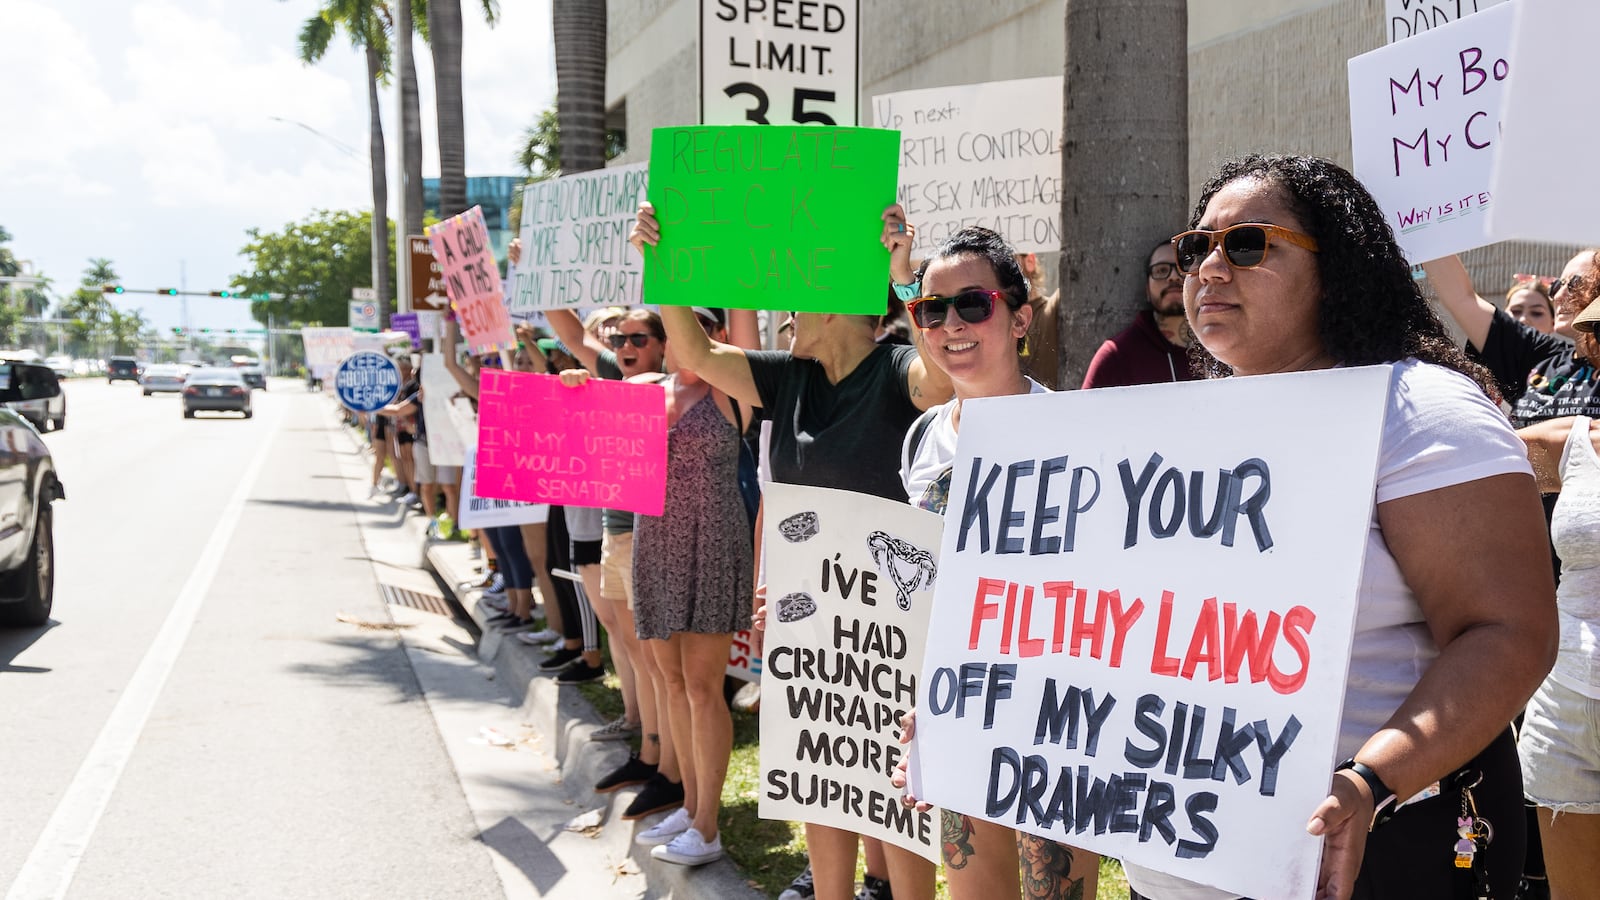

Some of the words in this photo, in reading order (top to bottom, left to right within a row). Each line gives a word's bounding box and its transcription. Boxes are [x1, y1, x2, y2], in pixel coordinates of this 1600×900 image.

[716, 0, 845, 33] SPEED
[730, 36, 832, 75] LIMIT
[1459, 47, 1510, 95] BO
[723, 82, 837, 126] 35
[878, 98, 903, 129] Up
[914, 102, 960, 124] next:
[672, 130, 857, 174] REGULATE
[898, 135, 946, 168] RTH
[957, 127, 1062, 163] CONTROL
[663, 184, 820, 232] DICK
[923, 180, 963, 214] SEX
[972, 174, 1064, 209] MARRIAGE
[441, 235, 456, 265] A
[527, 226, 561, 267] MORE
[570, 218, 636, 266] SUPREME
[448, 270, 467, 300] IN
[512, 270, 544, 307] THAN
[550, 268, 583, 307] THIS
[590, 268, 639, 304] COURT
[652, 246, 716, 285] NOT
[737, 248, 836, 291] JANE
[338, 369, 398, 387] ABORTION
[348, 353, 388, 370] KEEP
[481, 370, 526, 396] IF
[343, 386, 394, 404] LEGAL
[481, 425, 521, 448] IN
[534, 431, 566, 451] MY
[584, 435, 645, 456] UTERUS
[482, 447, 505, 469] I
[513, 452, 587, 475] WOULD
[502, 473, 517, 494] A
[536, 478, 623, 502] SENATOR
[956, 454, 1101, 555] KEEP
[1117, 452, 1274, 553] YOUR
[821, 552, 878, 607] I'VE
[833, 615, 908, 660] HAD
[968, 577, 1145, 668] FILTHY
[1150, 590, 1316, 695] LAWS
[768, 646, 916, 707] CRUNCH
[786, 685, 907, 740] WRAPS
[929, 663, 1017, 730] OFF
[1033, 677, 1116, 757] MY
[1124, 693, 1303, 796] SILKY
[796, 729, 901, 778] MORE
[767, 769, 932, 846] SUPREME
[985, 746, 1220, 859] DRAWERS
